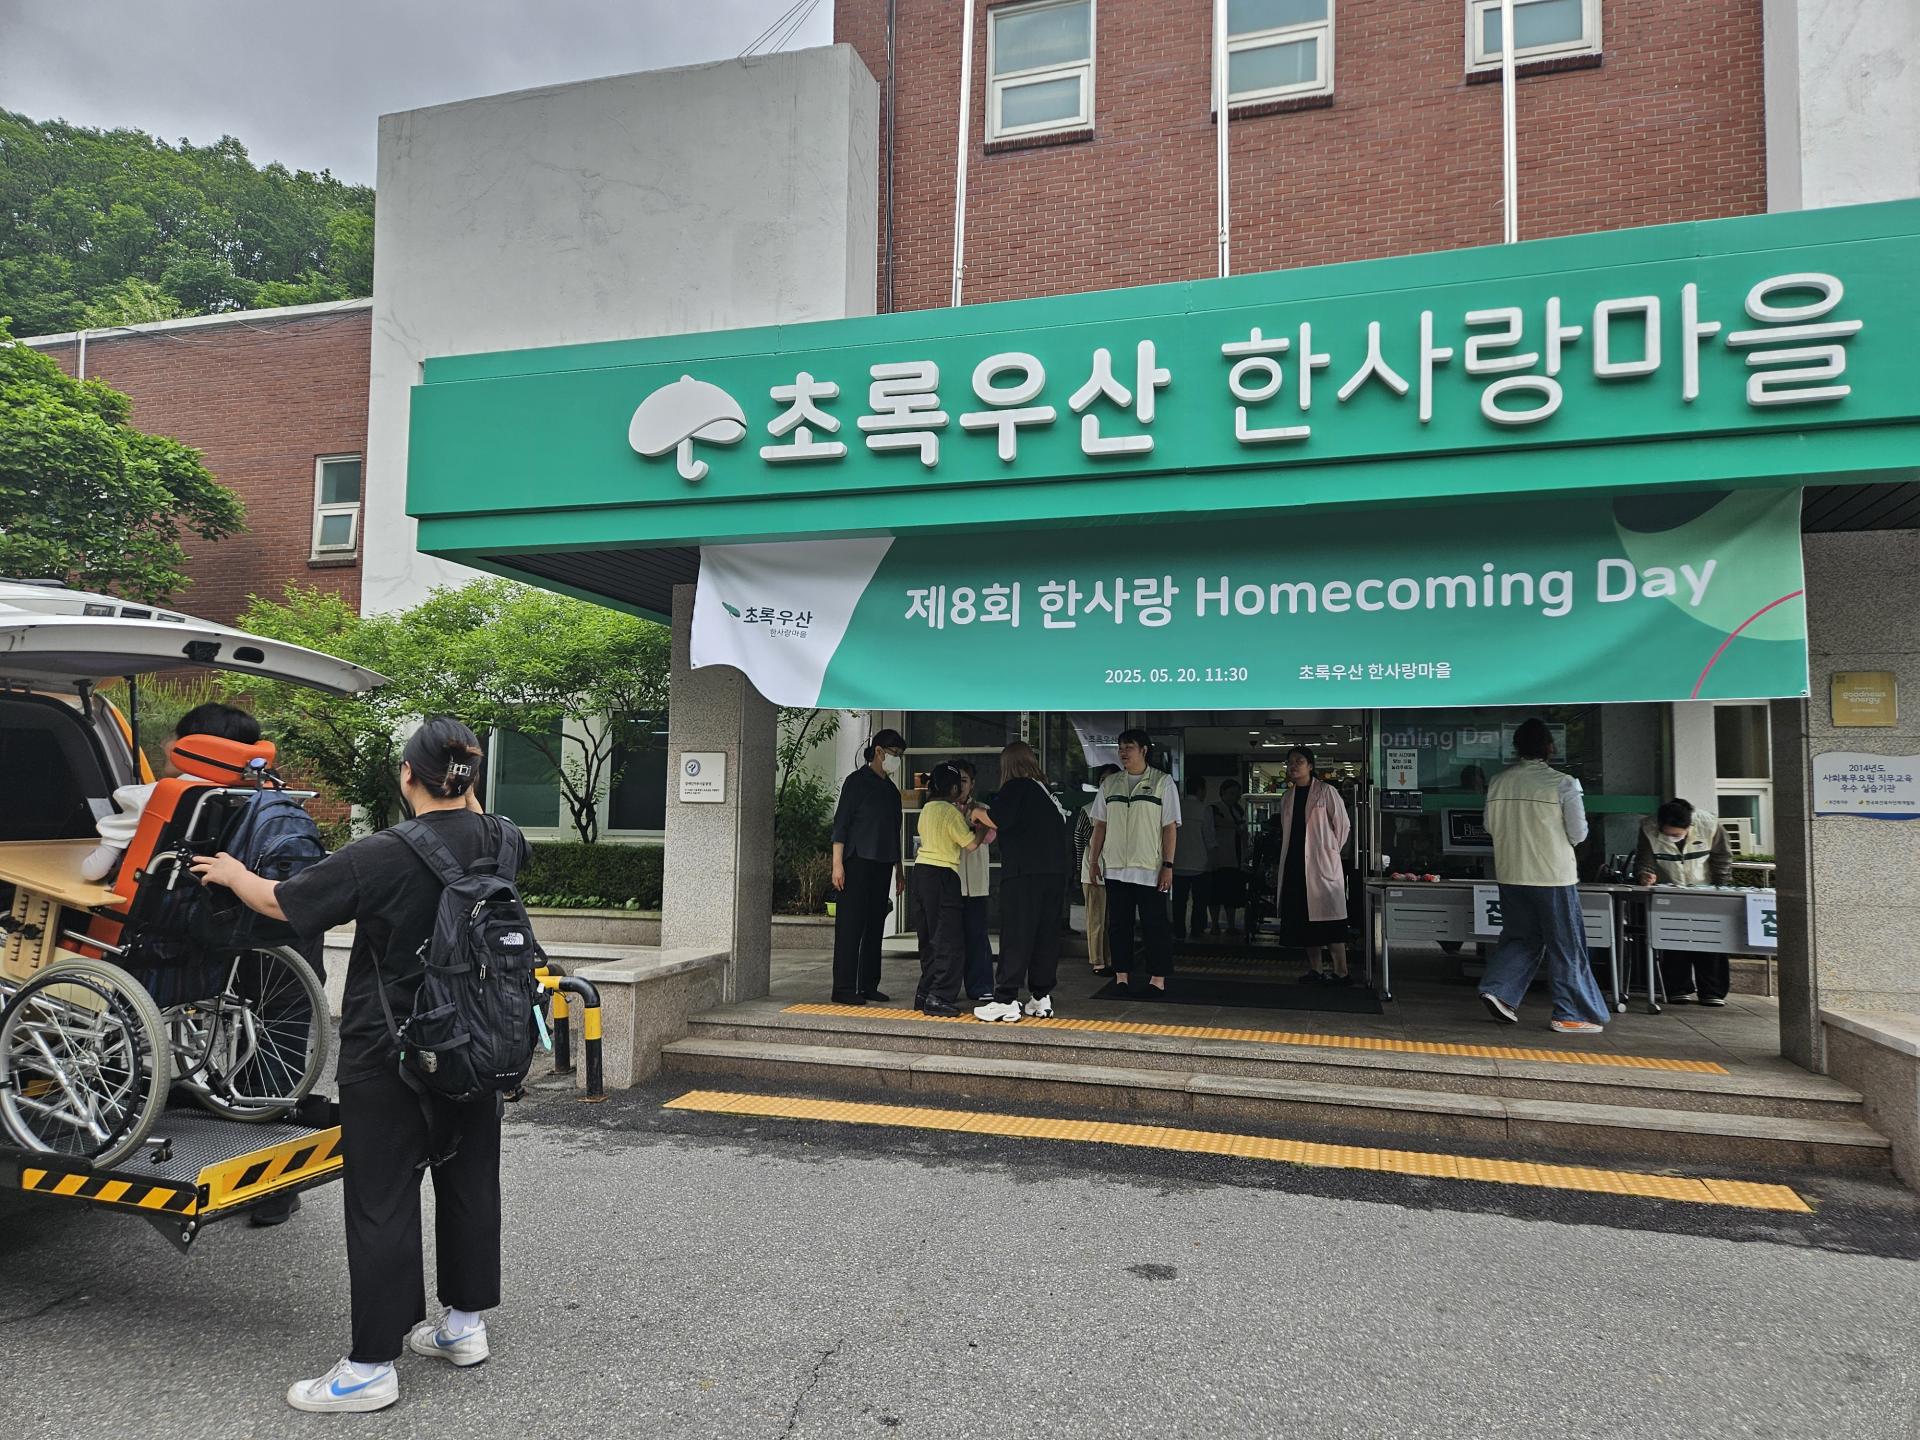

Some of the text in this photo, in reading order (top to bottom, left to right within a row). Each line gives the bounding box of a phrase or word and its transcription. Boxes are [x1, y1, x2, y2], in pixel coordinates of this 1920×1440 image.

[759, 271, 1864, 468] 초록우산 한사랑마을
[904, 557, 1718, 630] 제8회 한사랑 Homecoming Day
[743, 606, 814, 629] 초록우산
[769, 628, 808, 639] 한사랑마을
[1105, 662, 1452, 684] 2025. 05. 20. 11:30 초록우산 한사랑마을
[1848, 764, 1886, 772] 2014년도
[1822, 774, 1913, 783] 사회복무요원 직무교육
[1840, 784, 1896, 793] 우수 실습기관
